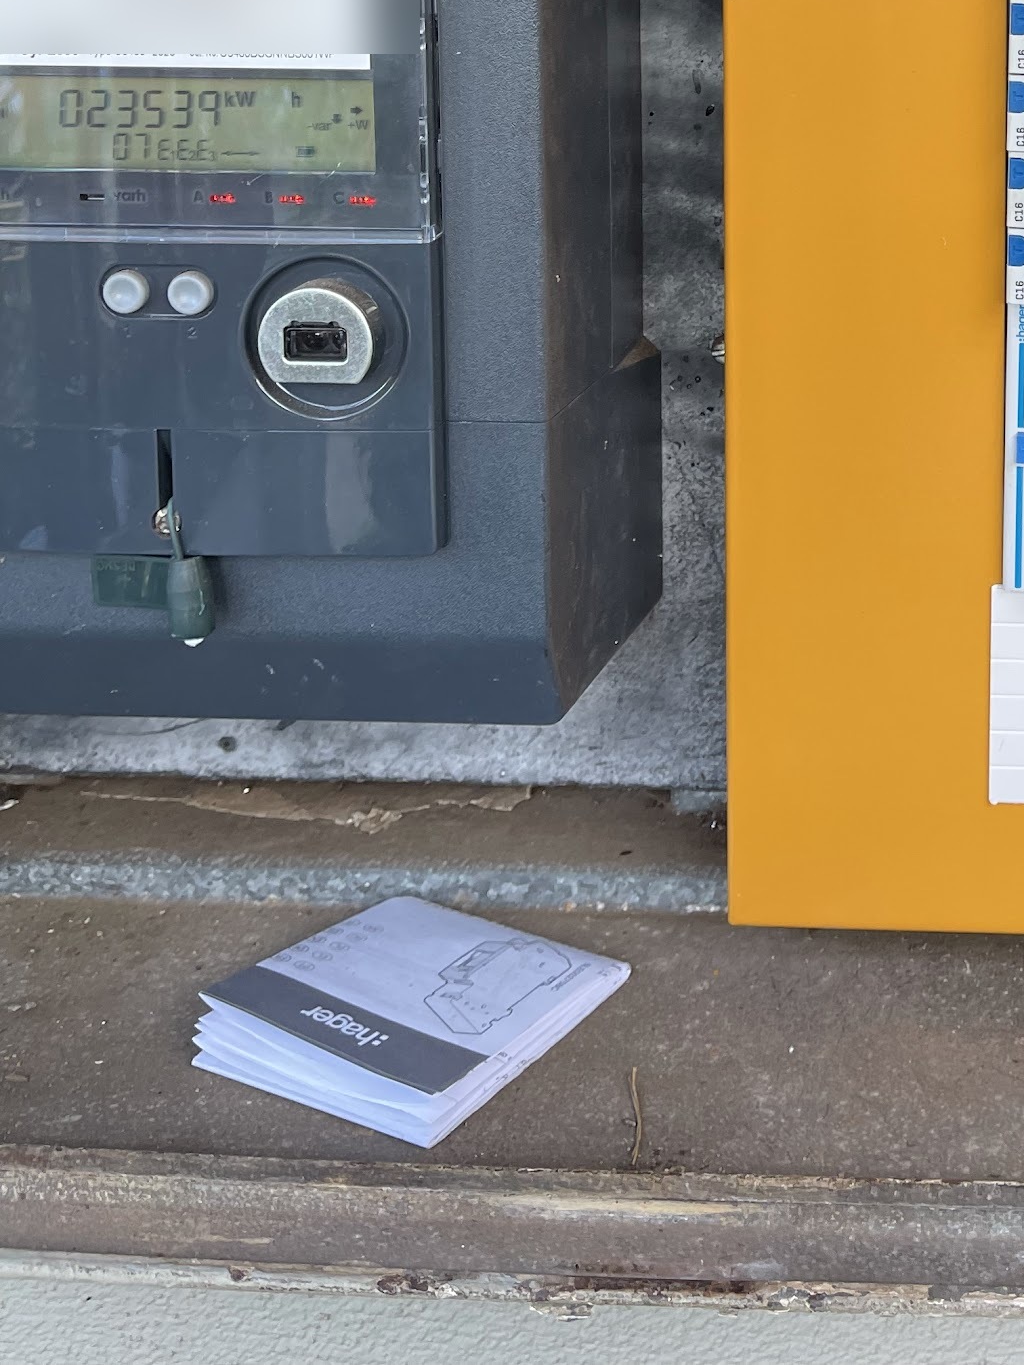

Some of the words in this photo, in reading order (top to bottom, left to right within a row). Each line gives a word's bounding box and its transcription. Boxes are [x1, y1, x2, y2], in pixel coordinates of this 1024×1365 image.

[59, 89, 222, 128] 023539
[224, 90, 256, 108] kW
[113, 133, 150, 161] 07
[194, 190, 205, 203] A
[265, 190, 274, 203] B
[333, 191, 345, 204] C
[1015, 201, 1024, 222] C16
[1015, 279, 1024, 300] C16
